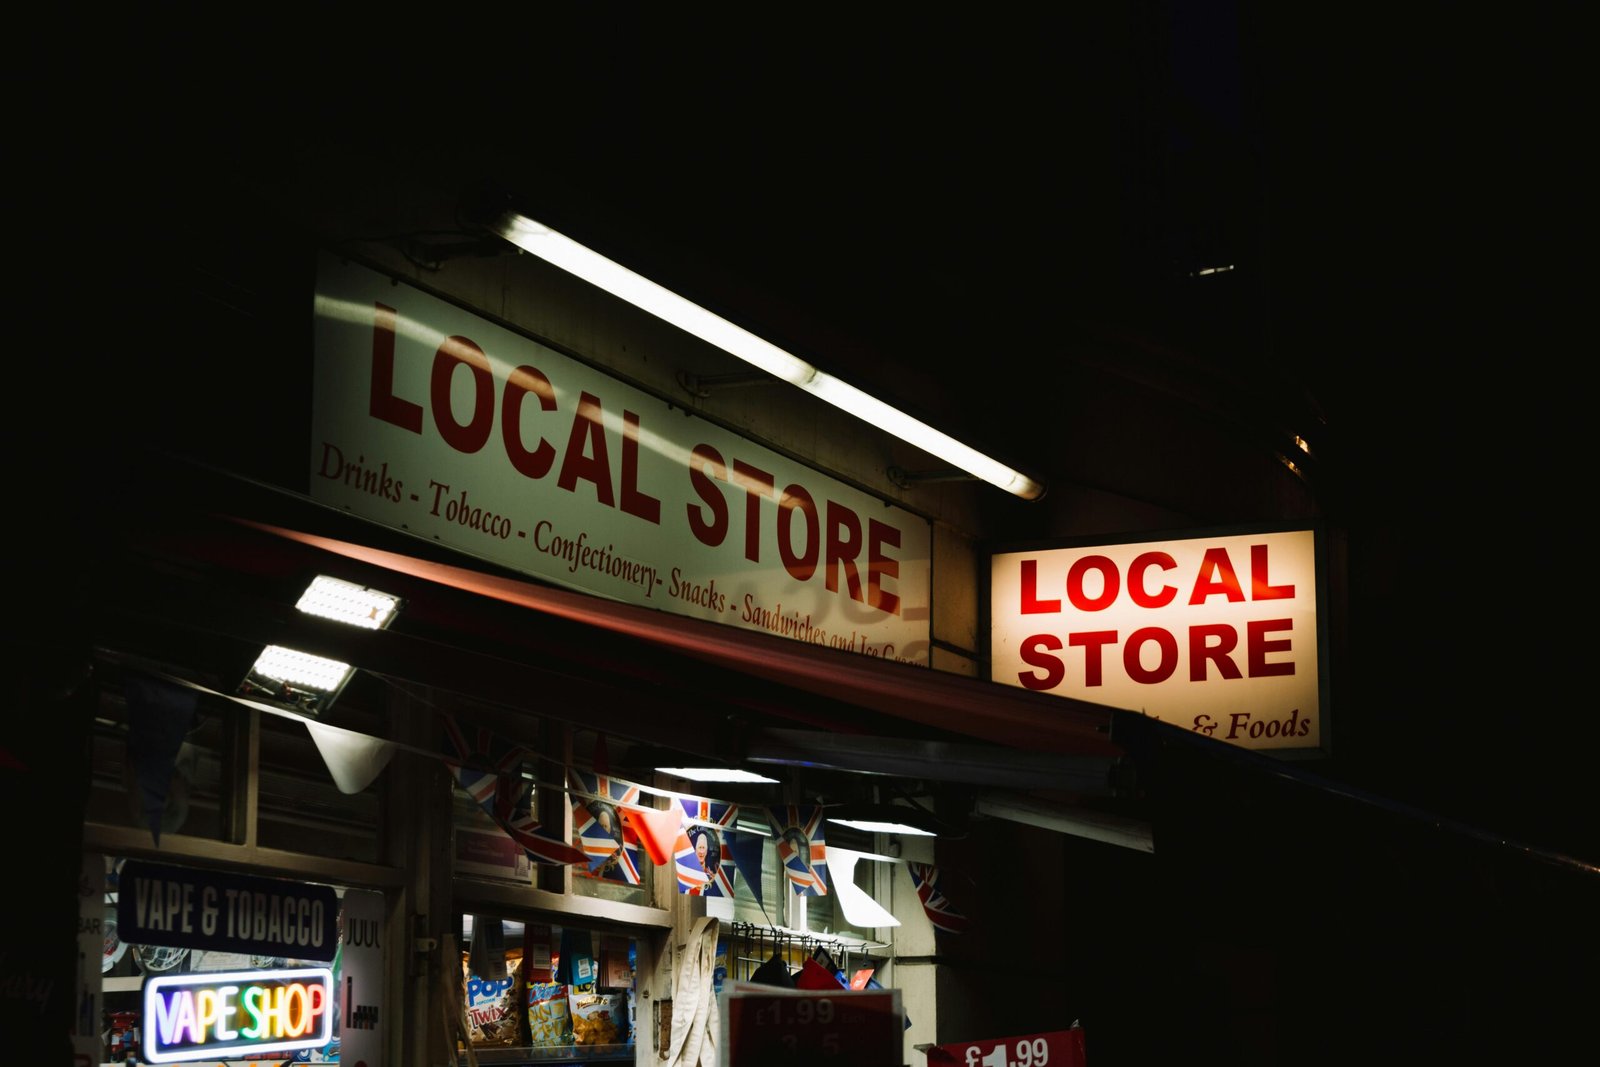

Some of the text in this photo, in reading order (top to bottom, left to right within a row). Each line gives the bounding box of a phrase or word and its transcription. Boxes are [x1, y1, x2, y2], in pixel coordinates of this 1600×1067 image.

[369, 300, 902, 617] LOCAL STORE
[317, 442, 403, 505] Drinks
[429, 479, 512, 541] Tobacco
[669, 567, 726, 614] Snacks
[742, 592, 827, 649] Sandwiches
[829, 630, 856, 656] and
[858, 634, 879, 658] Ice
[1019, 544, 1296, 615] LOCAL
[1017, 618, 1297, 692] STORE
[1225, 709, 1311, 740] Foods
[134, 876, 325, 949] VAPE & TOBACCO
[154, 982, 326, 1046] VAPE SHOP
[467, 974, 515, 1007] POP
[755, 997, 836, 1027] £1.99
